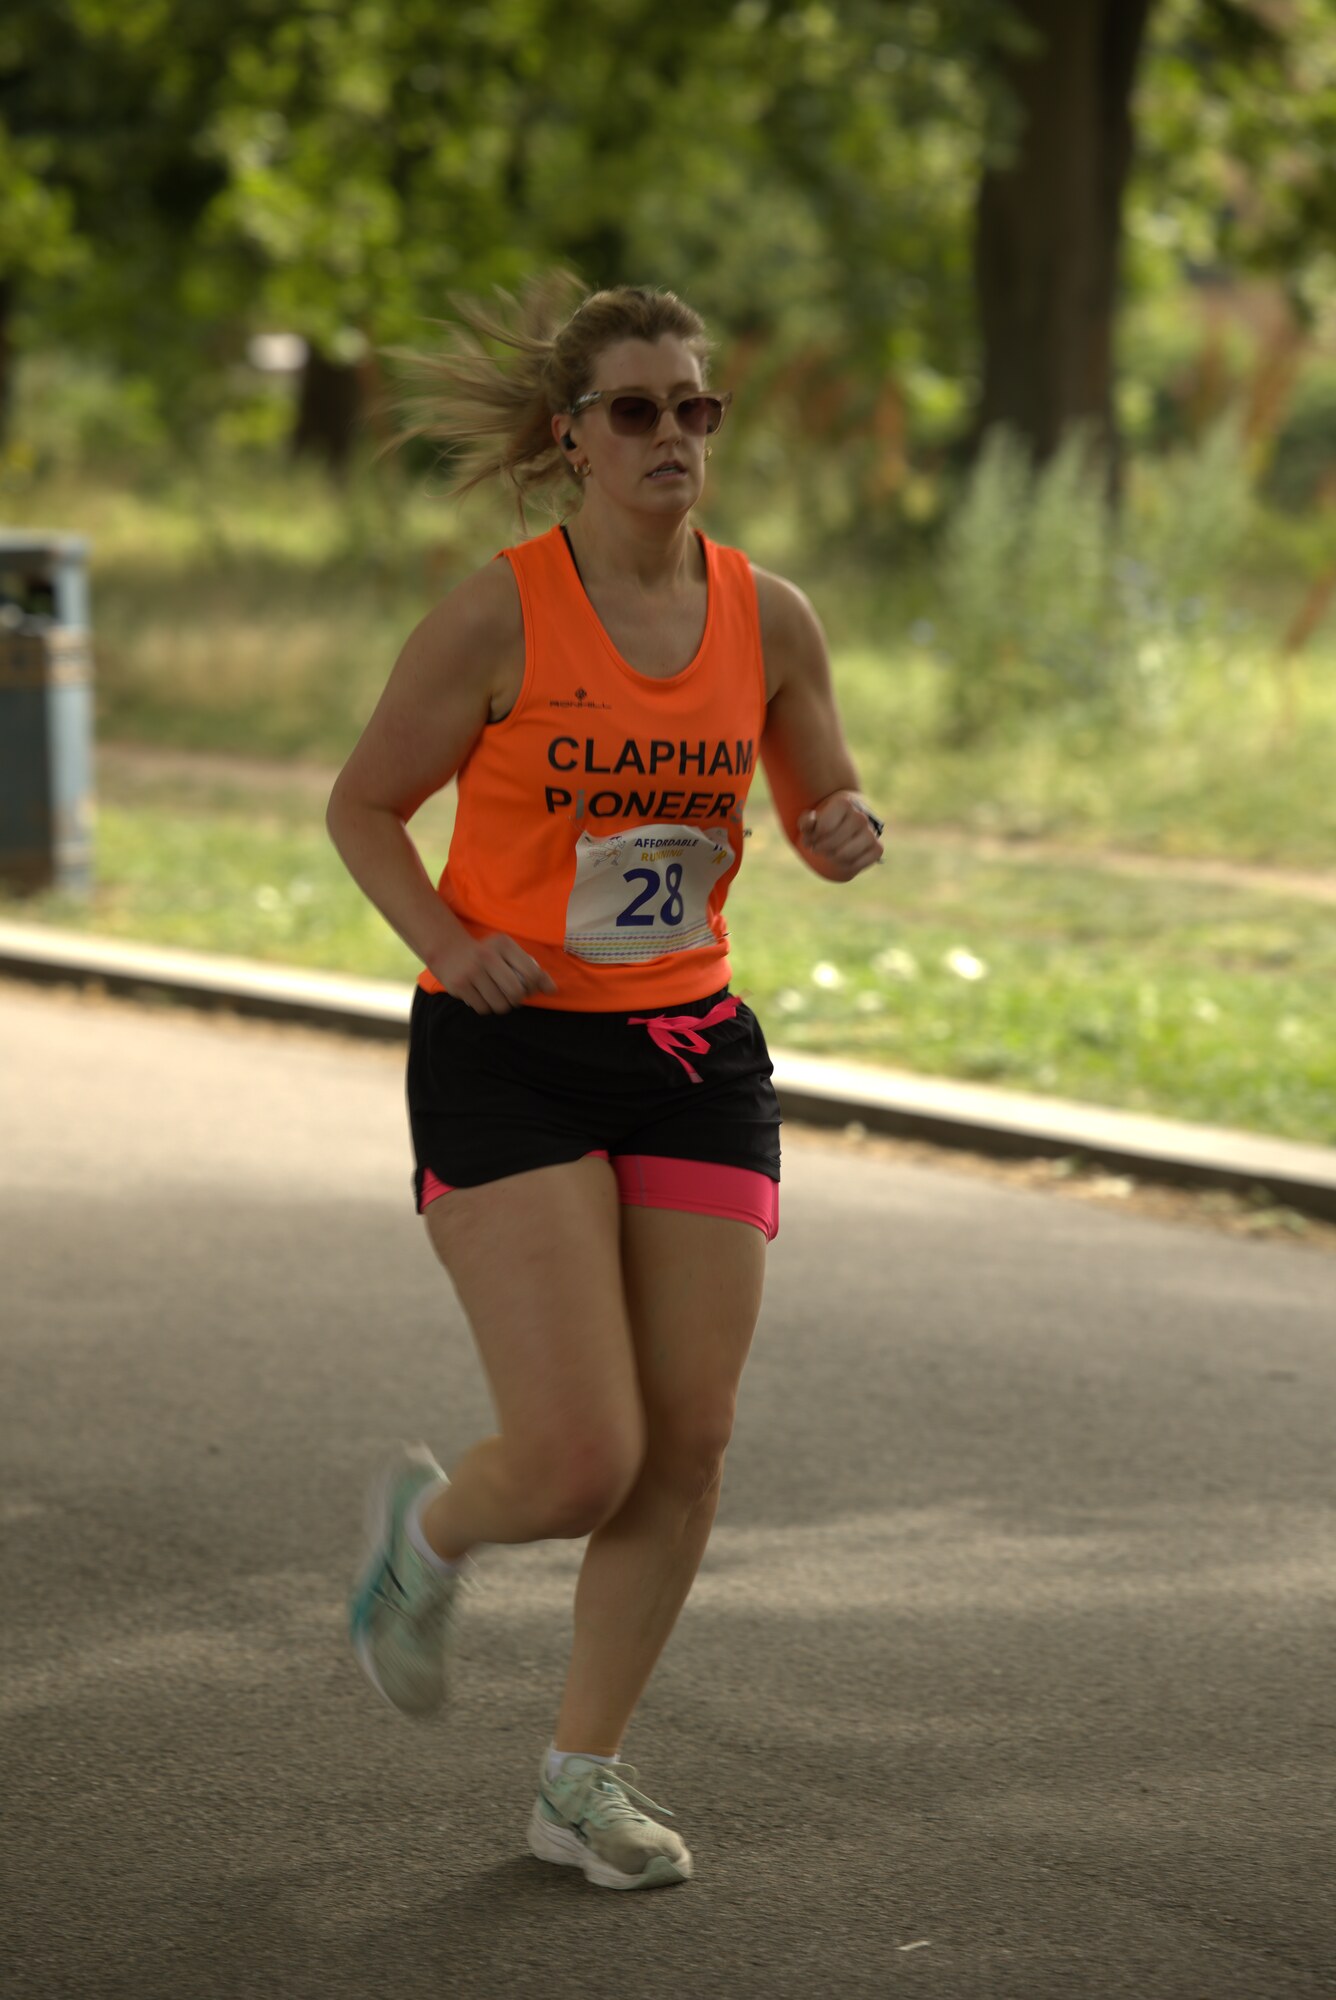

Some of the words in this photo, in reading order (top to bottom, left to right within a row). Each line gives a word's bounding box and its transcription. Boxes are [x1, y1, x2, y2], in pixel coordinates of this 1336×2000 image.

[547, 736, 753, 776] CLAPHAM
[634, 838, 699, 849] AFFORDABLE
[640, 849, 684, 863] RUNNING
[615, 862, 685, 927] 28
